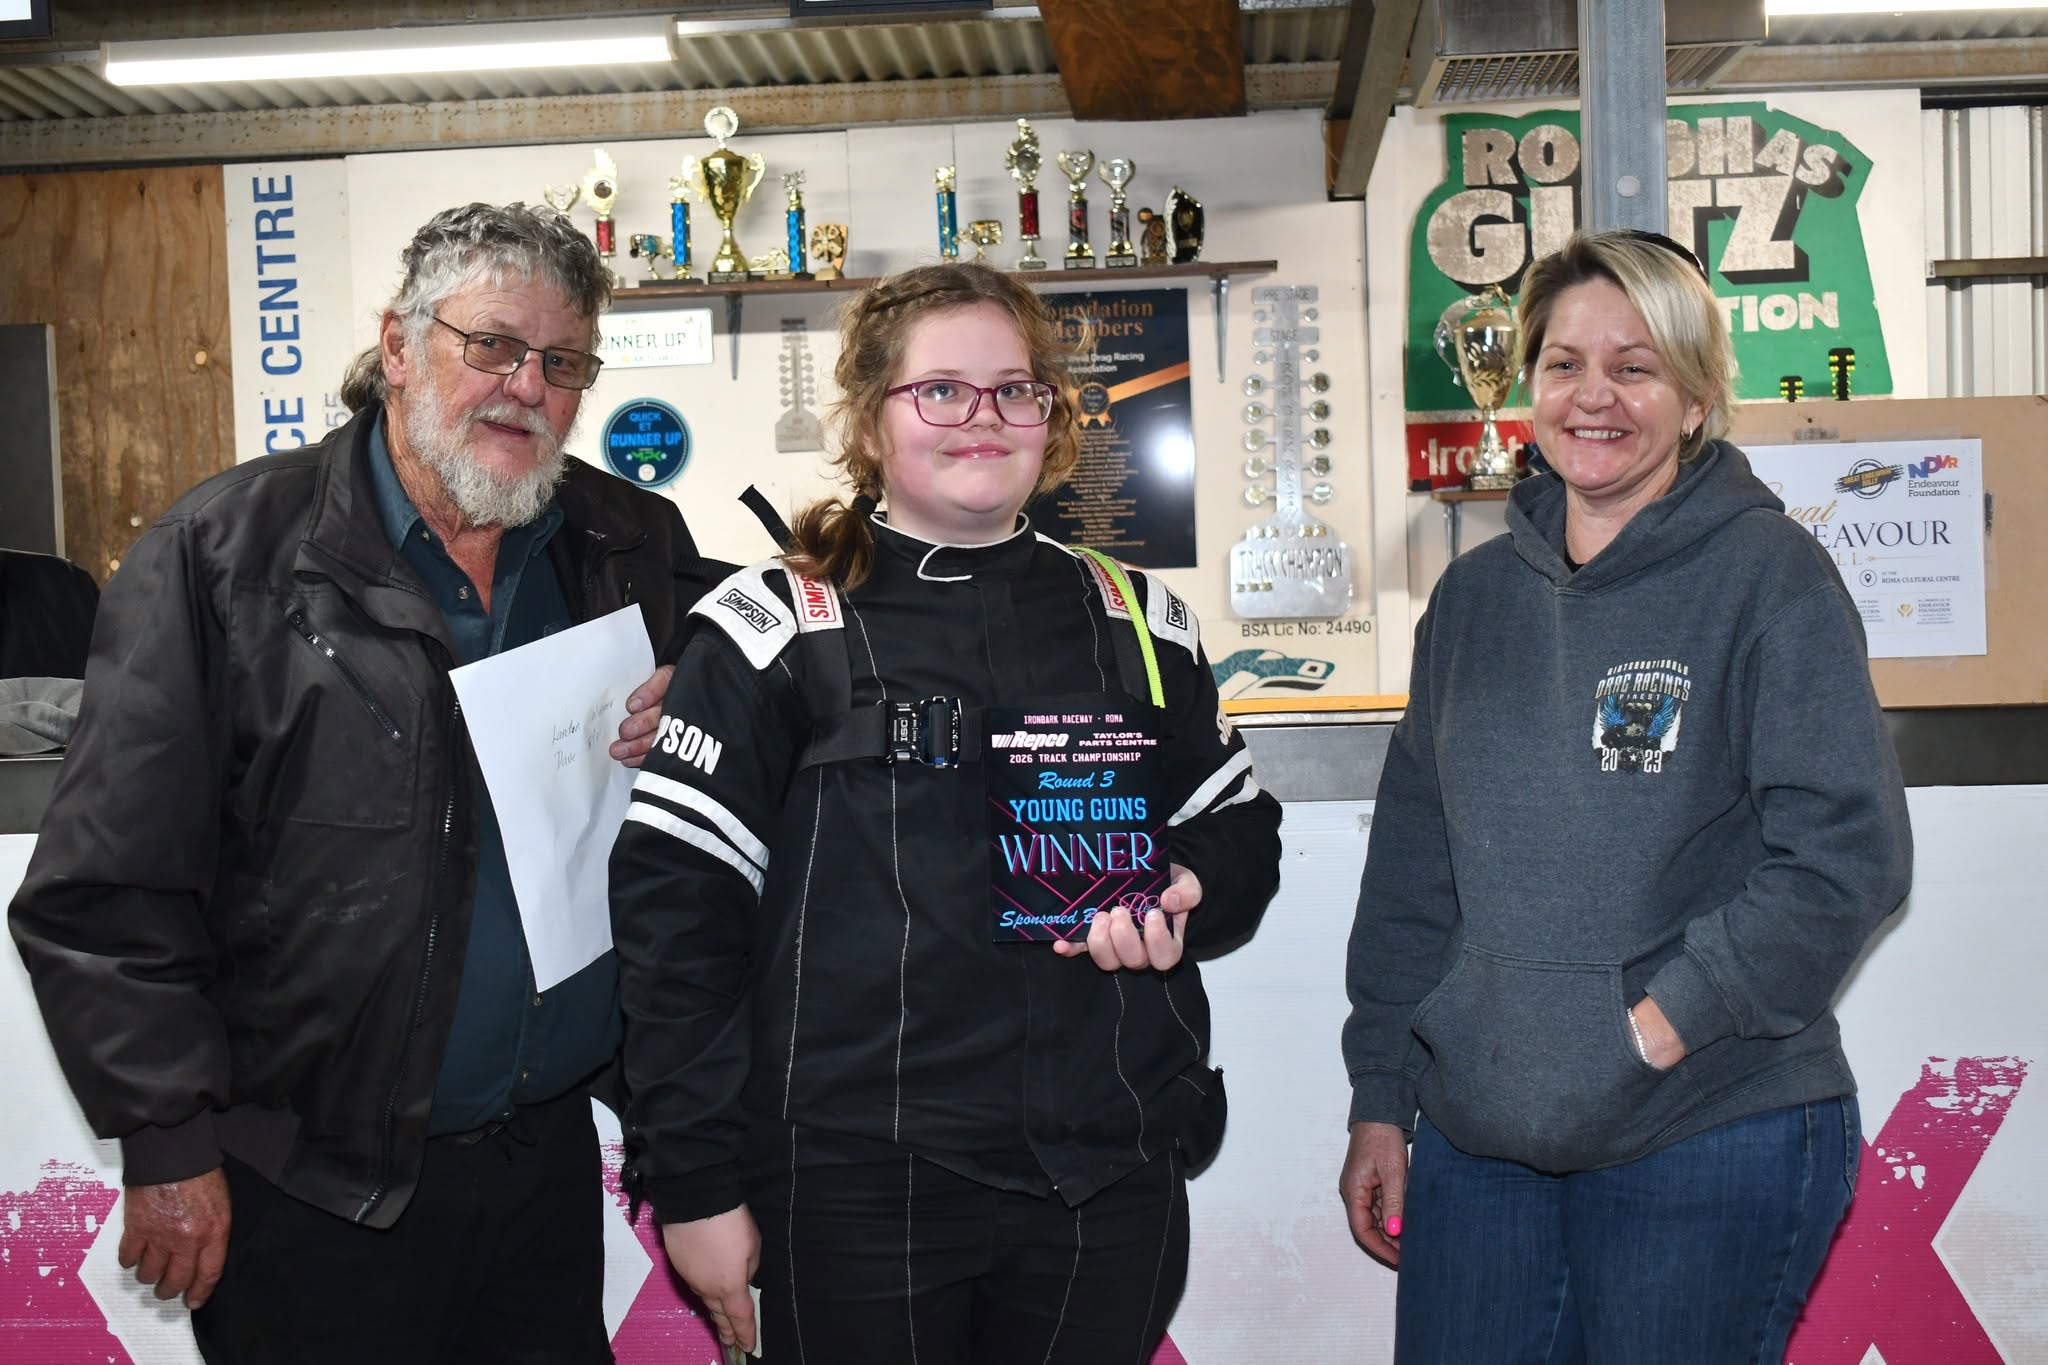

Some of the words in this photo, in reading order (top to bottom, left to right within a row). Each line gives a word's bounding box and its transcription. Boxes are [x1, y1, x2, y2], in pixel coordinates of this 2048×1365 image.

[252, 175, 303, 376] CENTRE
[1284, 288, 1310, 300] STAGE
[1044, 299, 1154, 319] oundation
[1715, 292, 1840, 334] TION
[600, 334, 658, 351] UNNER
[665, 332, 686, 348] UP
[1270, 329, 1298, 343] STAGE
[1090, 353, 1113, 363] Drag
[1114, 352, 1145, 362] Racing
[264, 397, 306, 455] CE
[629, 411, 662, 423] QUICK
[639, 422, 652, 431] ET
[610, 432, 661, 447] RUNNER
[664, 431, 683, 446] UP
[1908, 480, 1960, 489] Endeavour
[1908, 488, 1960, 498] Foundation
[1788, 500, 1838, 524] eat
[1811, 520, 1952, 549] EAVOUR
[1281, 547, 1343, 579] CHAMPION
[1836, 552, 1863, 566] LL
[801, 575, 830, 619] SIMPS
[723, 591, 774, 631] SIMPSON
[1241, 623, 1271, 637] BSA
[1274, 623, 1294, 636] Lic
[1298, 622, 1321, 636] No:
[1326, 620, 1372, 636] 24490
[1594, 673, 1632, 699] DRAG
[1632, 672, 1692, 702] RACINGS
[1618, 693, 1662, 701] FINEST
[1023, 714, 1059, 725] IRONBARK
[1062, 714, 1093, 724] RACEWAY
[1105, 714, 1124, 723] ROMA
[652, 714, 723, 776] PSON
[1010, 730, 1070, 751] Repco
[1079, 739, 1113, 747] PARTS
[1115, 738, 1157, 746] CENTRE
[1092, 732, 1143, 740] TAYLOR'S
[1009, 753, 1033, 764] 2026
[1038, 753, 1067, 763] TRACK
[1072, 752, 1142, 763] CHAMPIONSHIP
[1600, 747, 1618, 772] 20
[1643, 749, 1663, 773] 23
[1038, 771, 1095, 790] Round
[1099, 770, 1116, 788] 3
[1009, 798, 1084, 823] YOUNG
[1090, 797, 1148, 821] GUNS
[999, 832, 1155, 875] WINNER
[1000, 908, 1078, 930] Sponsored
[1083, 908, 1098, 925] B
